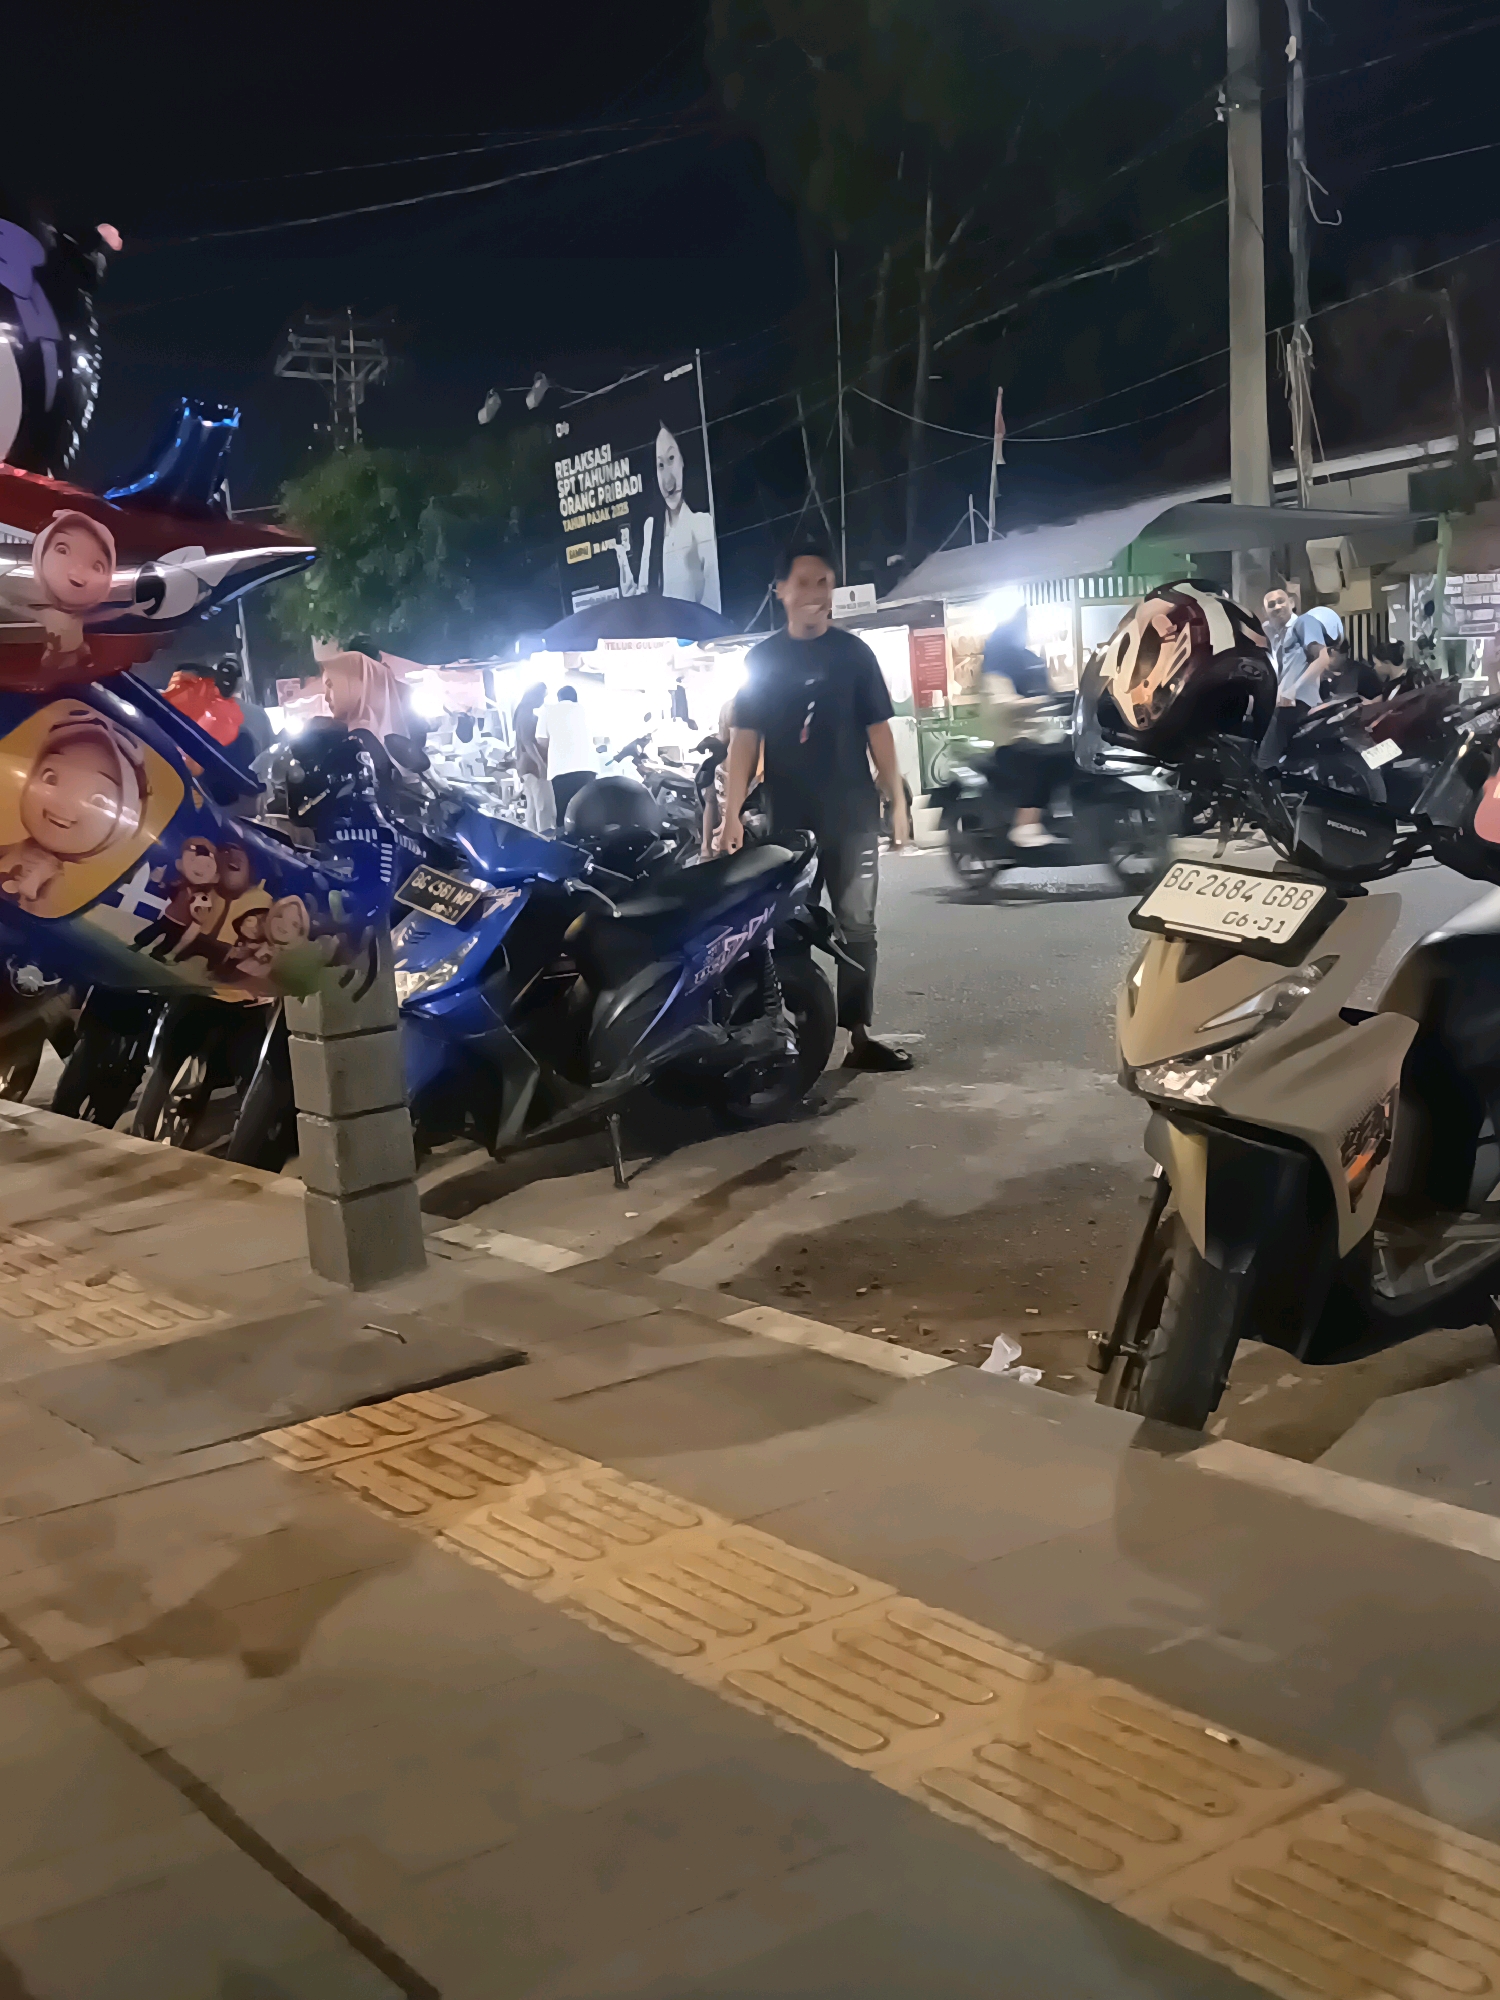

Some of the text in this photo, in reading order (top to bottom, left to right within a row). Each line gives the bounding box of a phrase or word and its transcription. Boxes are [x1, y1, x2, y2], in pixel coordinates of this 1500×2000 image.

[555, 443, 612, 480] RELAKSASI
[557, 457, 630, 499] SPT TAHUNAN
[559, 473, 643, 517] ORANG PRIBADI
[605, 641, 633, 651] TELUR
[1327, 819, 1367, 838] HONDA
[1163, 867, 1314, 911] BG 2684 GBB
